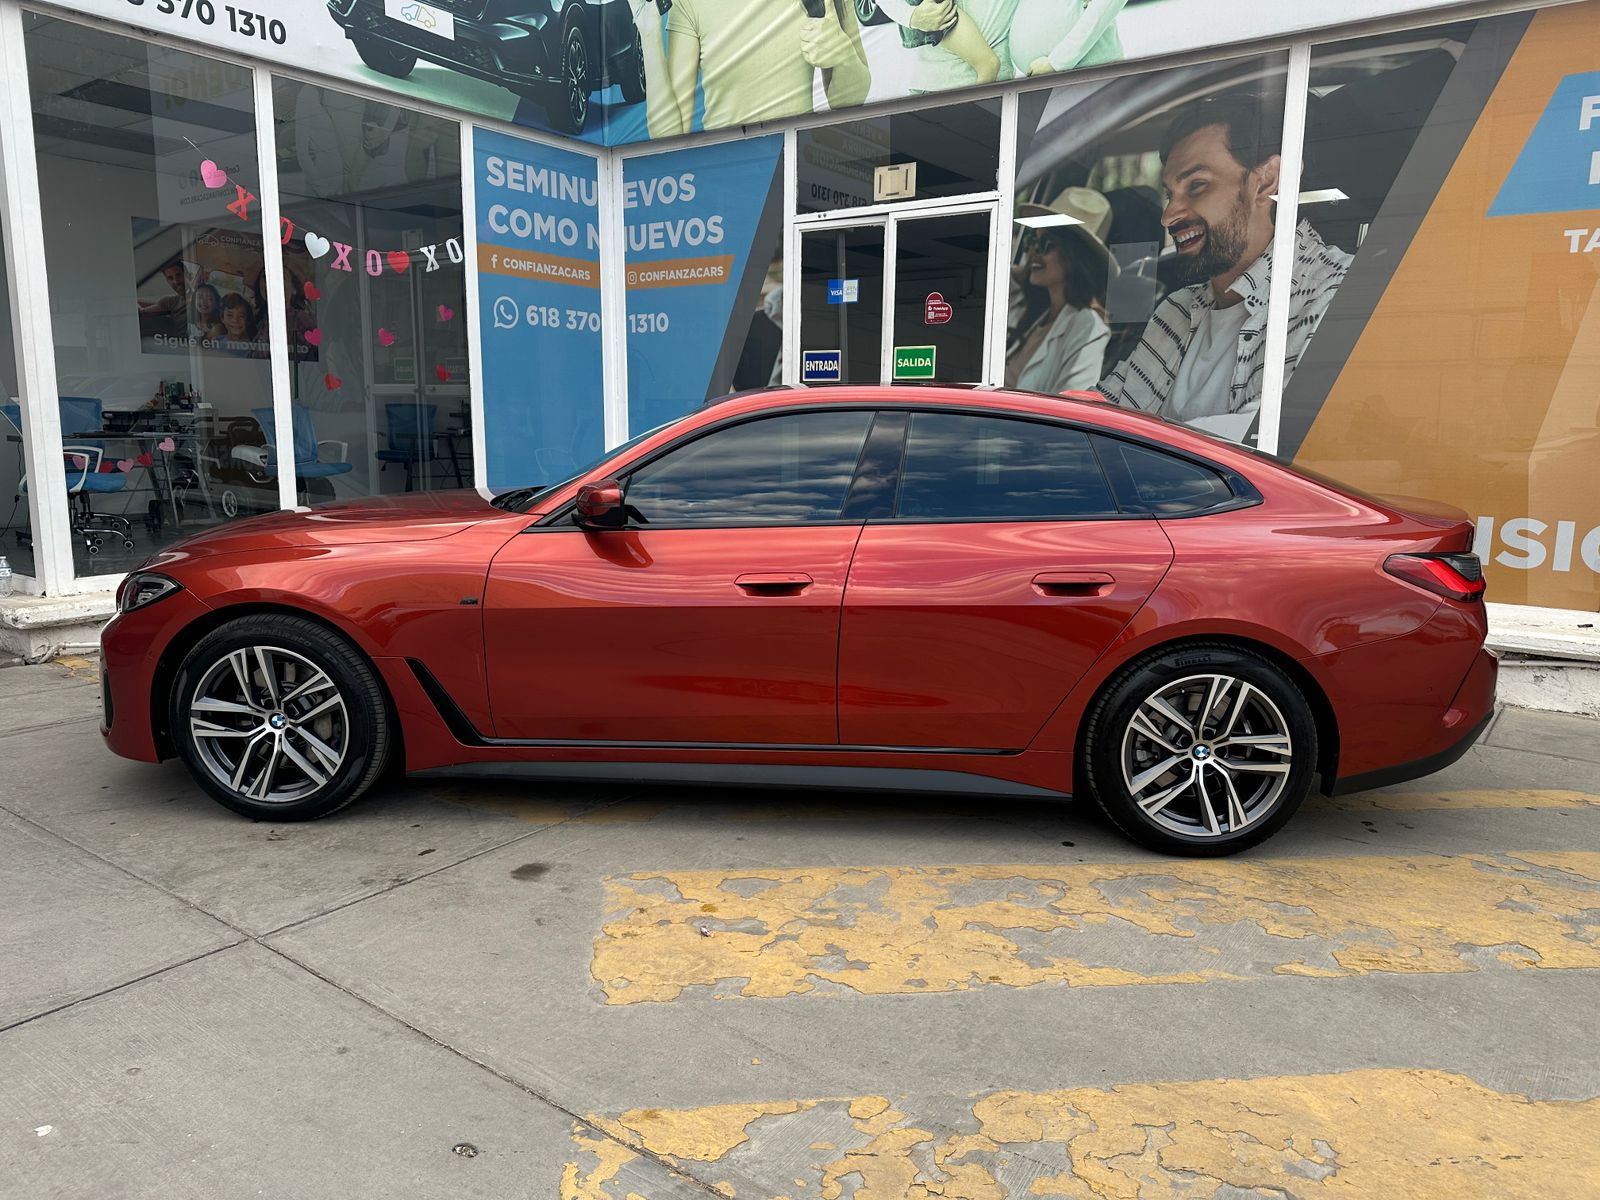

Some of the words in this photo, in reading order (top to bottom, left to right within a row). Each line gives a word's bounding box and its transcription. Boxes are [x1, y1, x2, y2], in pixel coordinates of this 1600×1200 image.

[225, 5, 287, 45] 1310
[488, 204, 578, 247] COMO
[502, 257, 591, 281] CONFIANZACARS
[639, 265, 724, 283] CONFIANZACARS
[526, 304, 560, 328] 618
[566, 309, 601, 332] 370
[629, 312, 669, 334] 1310
[153, 333, 198, 349] Sigue
[202, 339, 220, 349] en
[805, 360, 839, 372] ENTRADA
[897, 357, 932, 368] SALIDA
